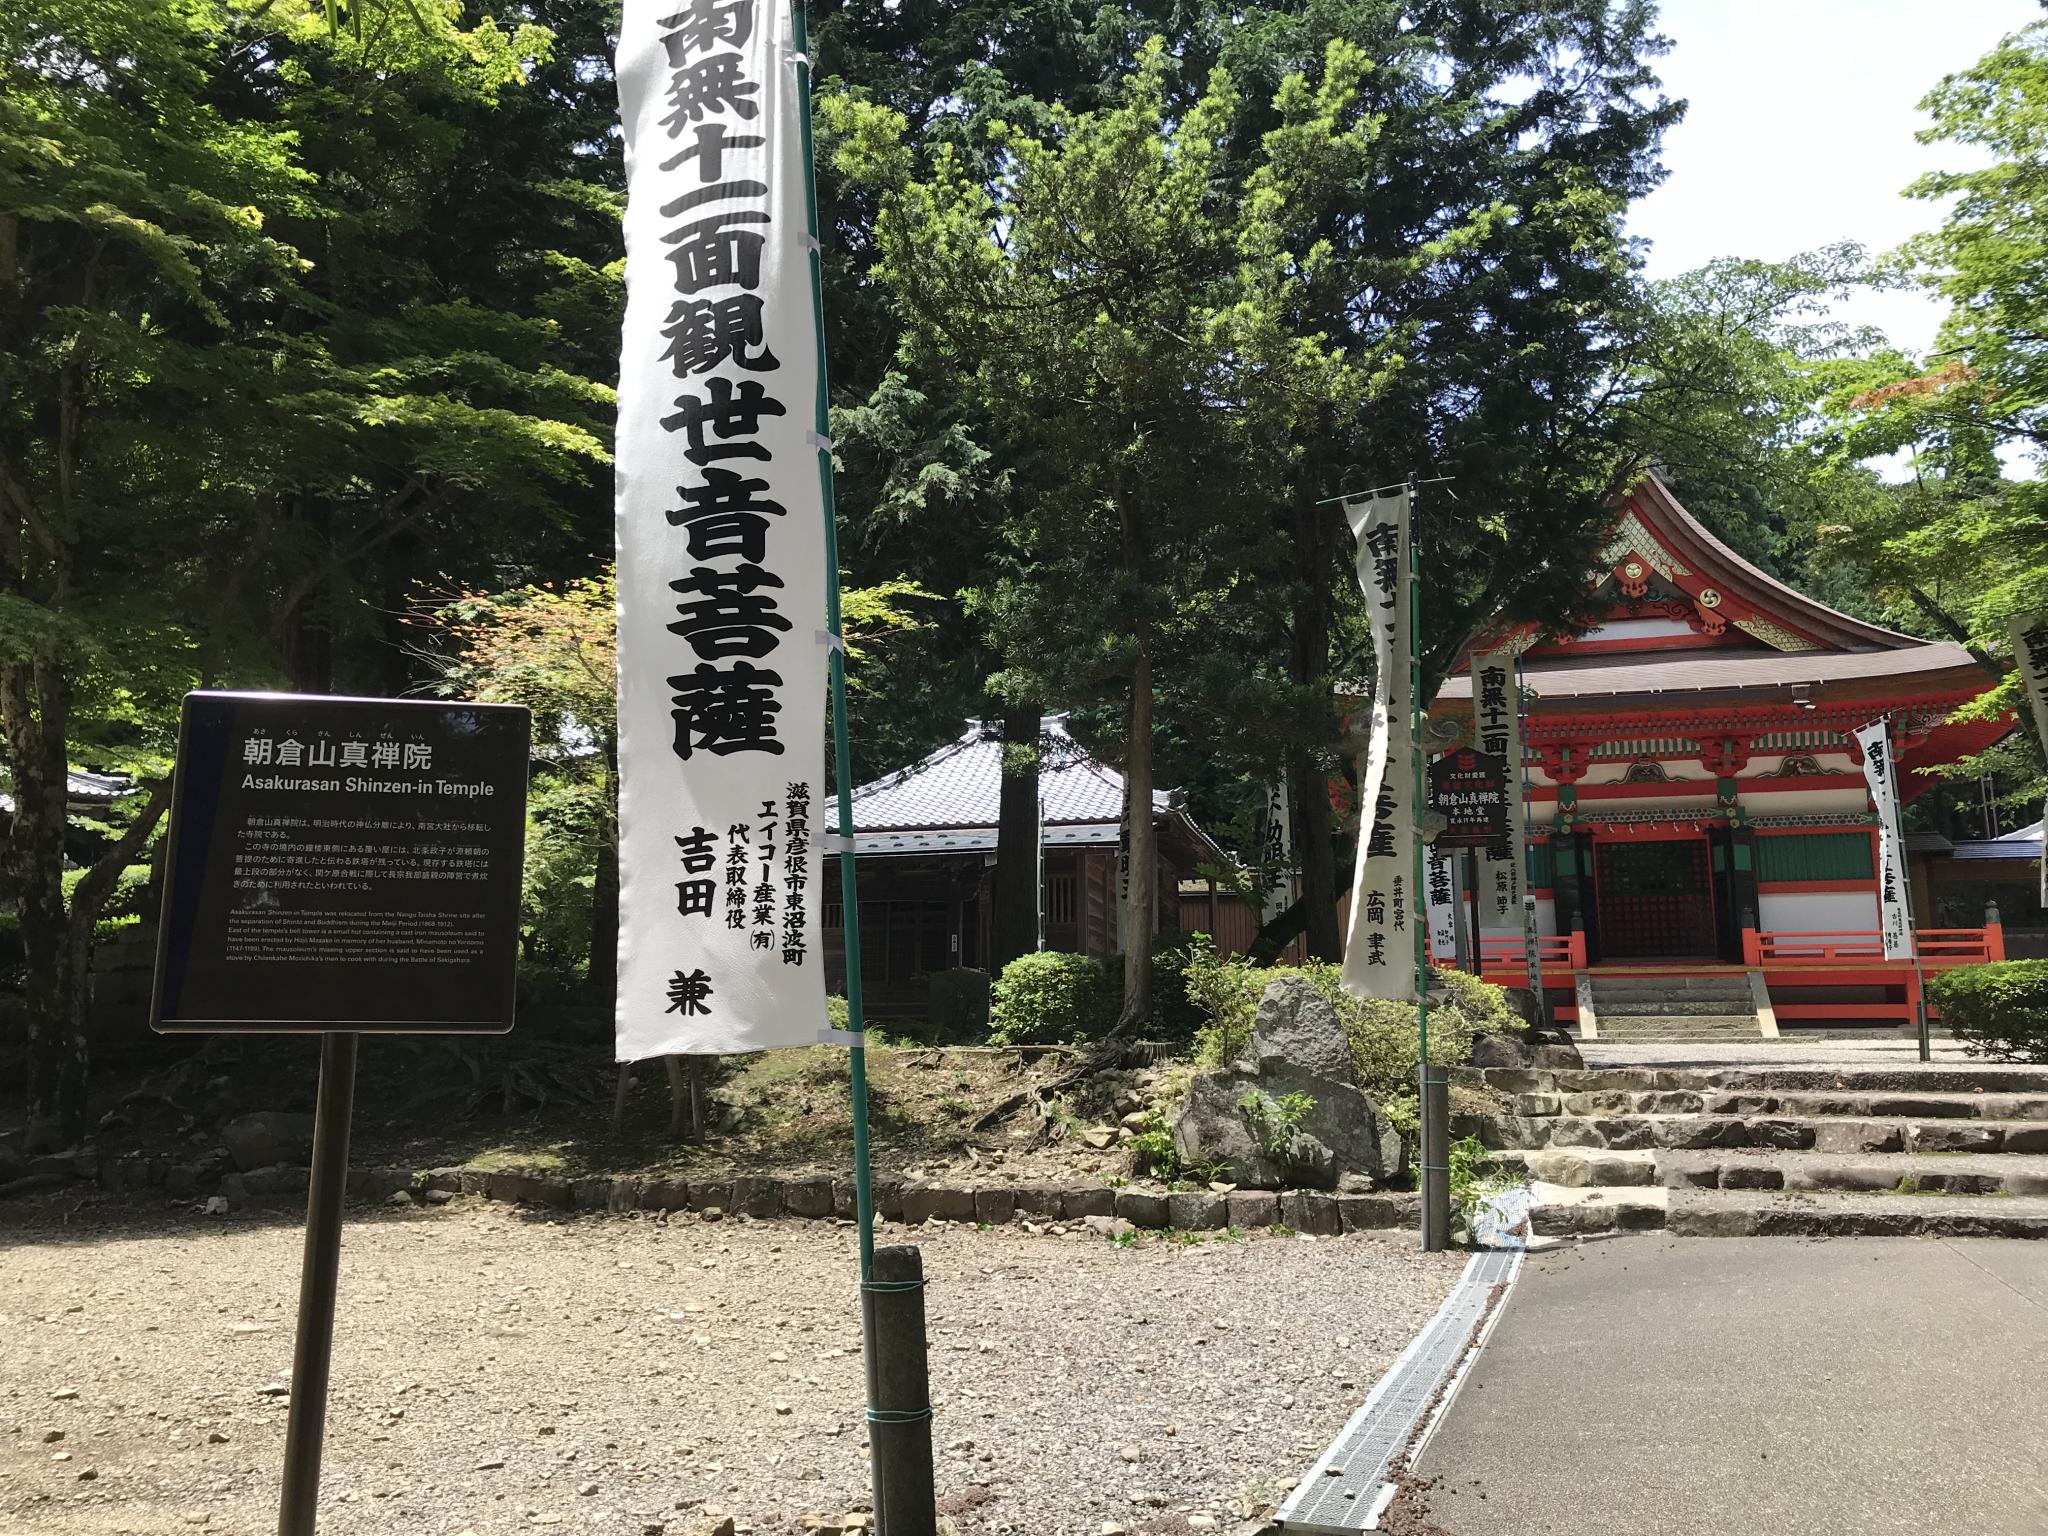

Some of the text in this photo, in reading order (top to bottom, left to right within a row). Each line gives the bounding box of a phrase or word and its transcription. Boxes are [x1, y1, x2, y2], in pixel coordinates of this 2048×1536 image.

[242, 737, 432, 770] 朝倉山真禅院
[241, 774, 494, 798] Asakurasan Shinzen-in Temple
[1438, 791, 1500, 806] 朝倉山真禅院
[237, 830, 290, 840] た寺院である。
[725, 823, 750, 930] 代表取締役
[782, 781, 810, 966] 滋賀県彦根市東沼波町
[664, 826, 719, 1016] 吉田 兼
